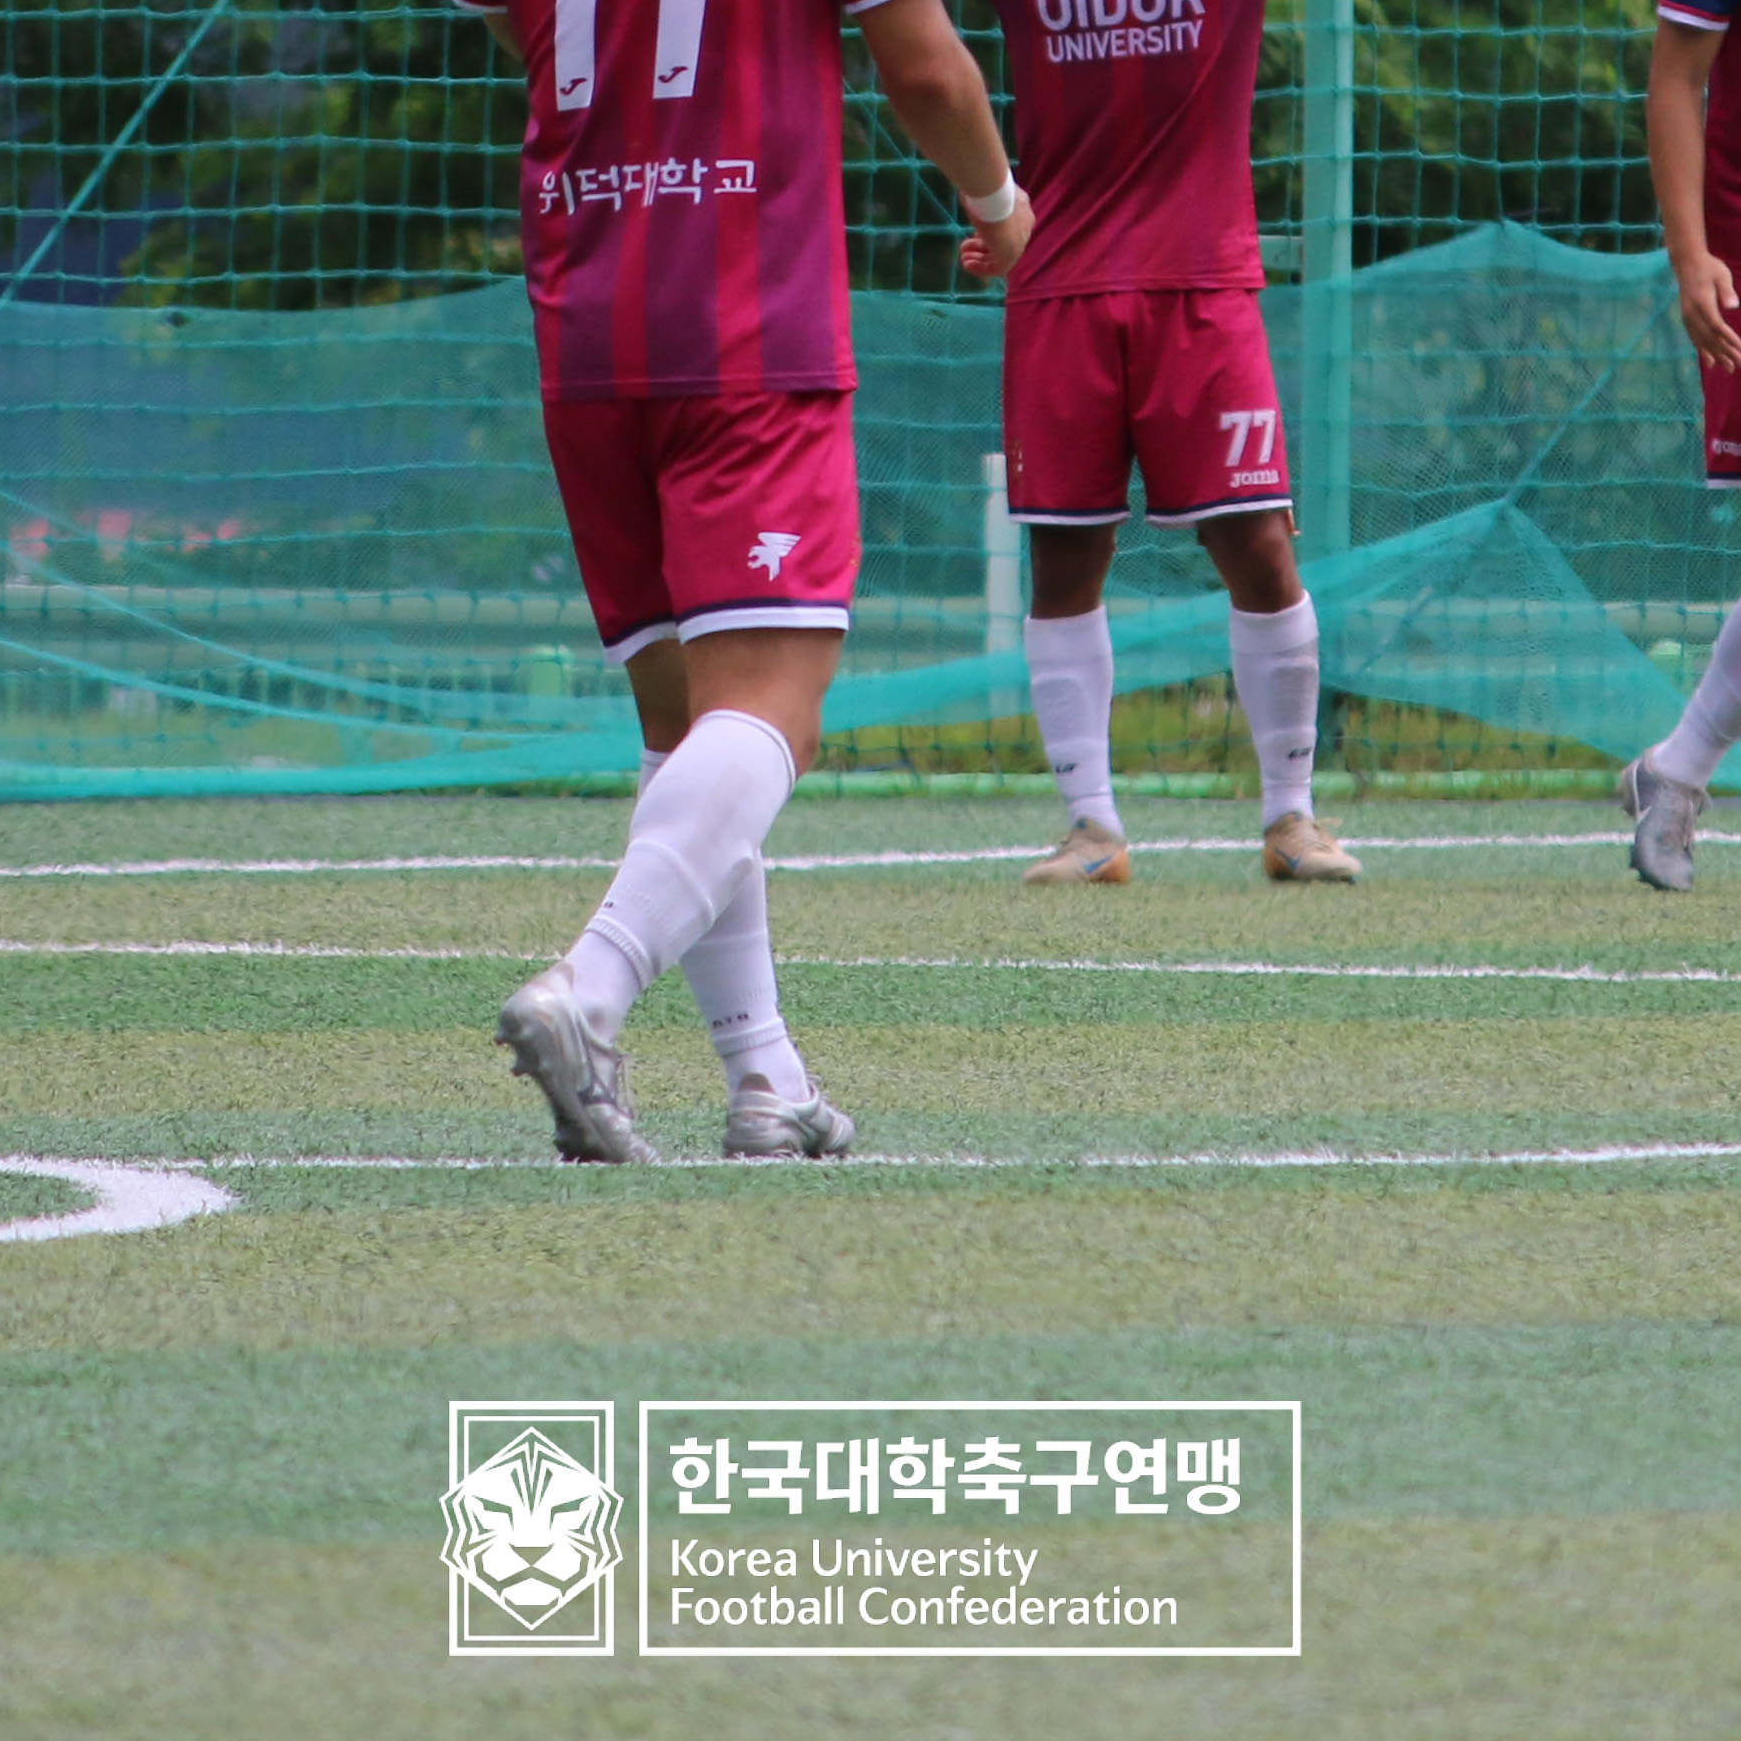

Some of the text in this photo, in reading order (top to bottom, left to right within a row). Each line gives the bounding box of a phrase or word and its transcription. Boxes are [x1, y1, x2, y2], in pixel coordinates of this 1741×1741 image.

[1045, 19, 1204, 64] UNIVERSITY
[539, 158, 757, 216] 위덕대학교
[1219, 410, 1276, 467] 77
